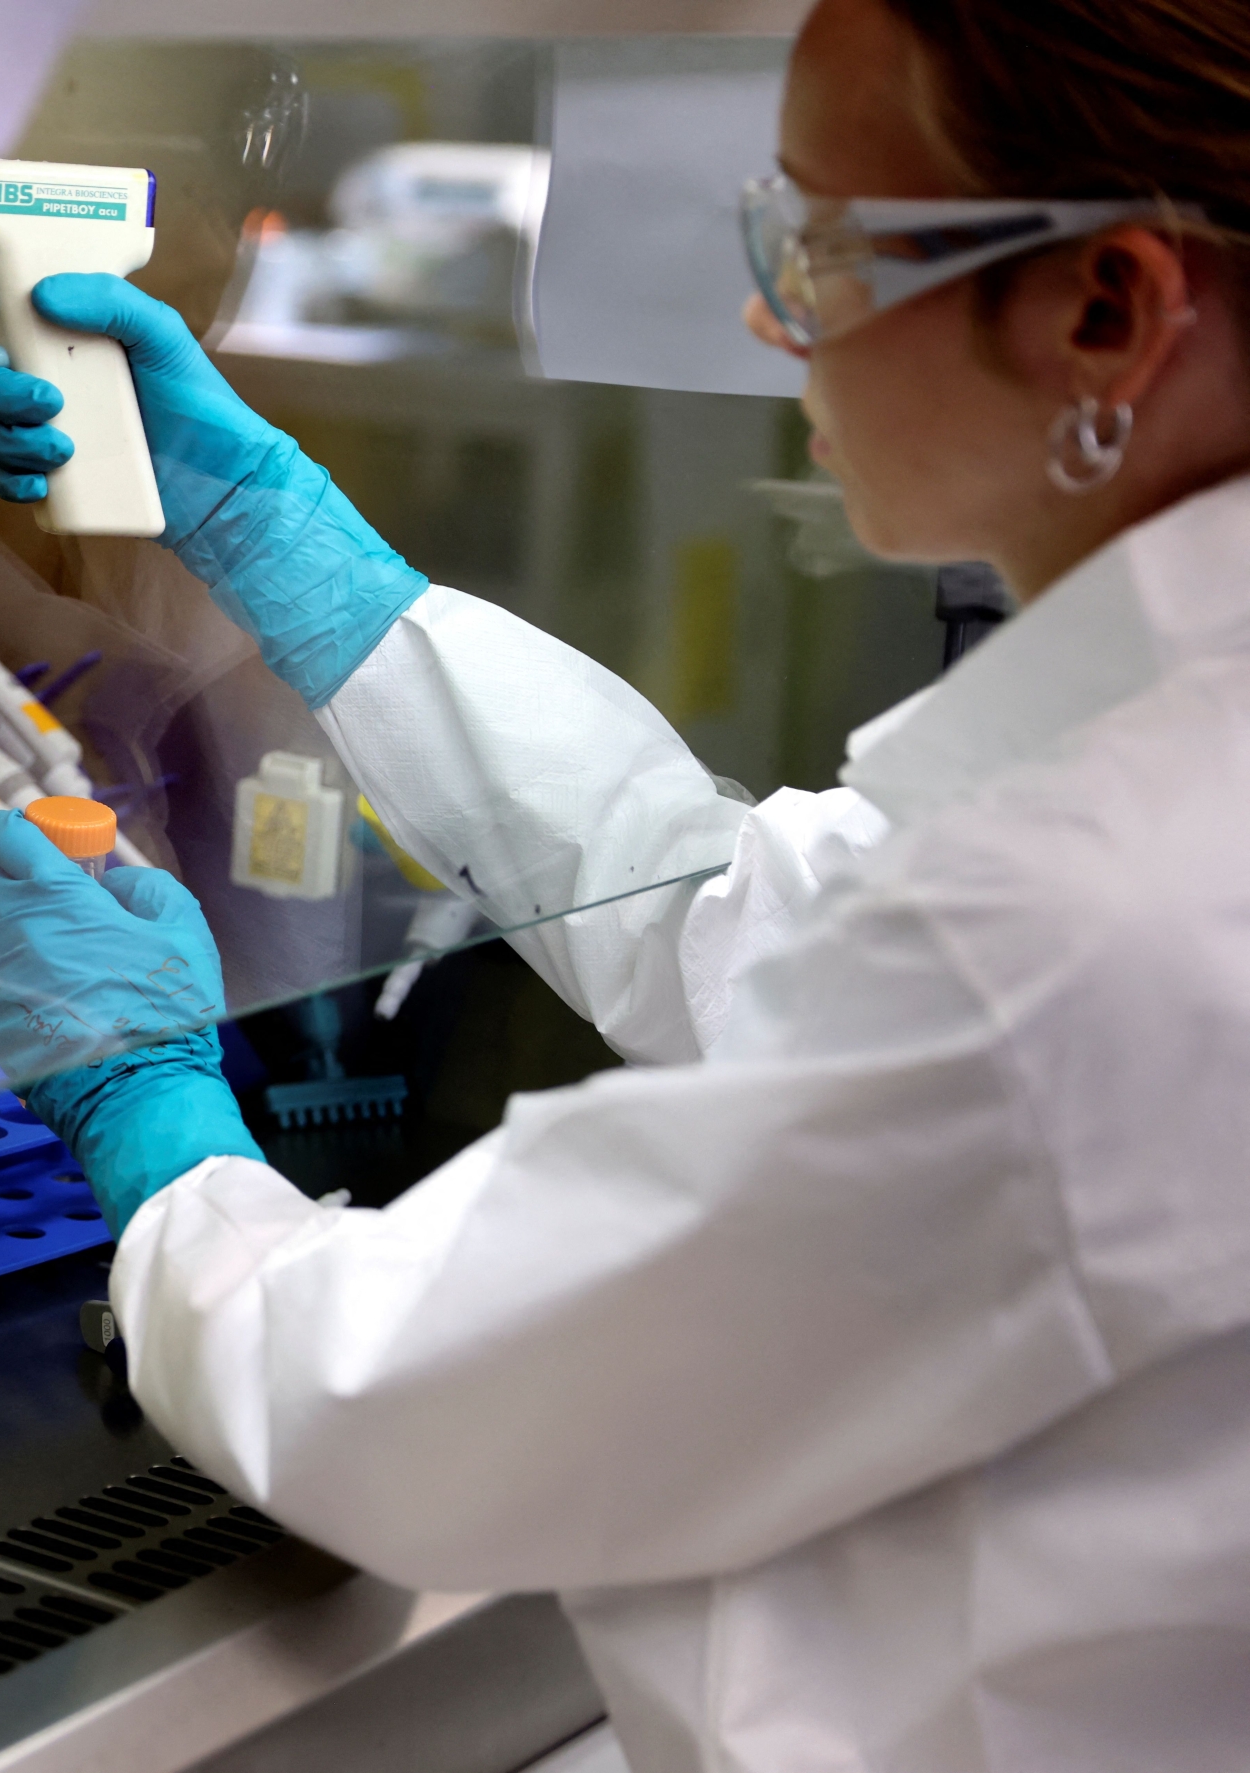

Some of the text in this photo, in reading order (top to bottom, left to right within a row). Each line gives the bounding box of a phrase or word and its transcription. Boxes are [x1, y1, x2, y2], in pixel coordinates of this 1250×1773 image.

[36, 186, 128, 200] INTEGRA BIOSCIENCES
[42, 202, 118, 217] PIPETBOY acu
[103, 1319, 112, 1341] 1000
